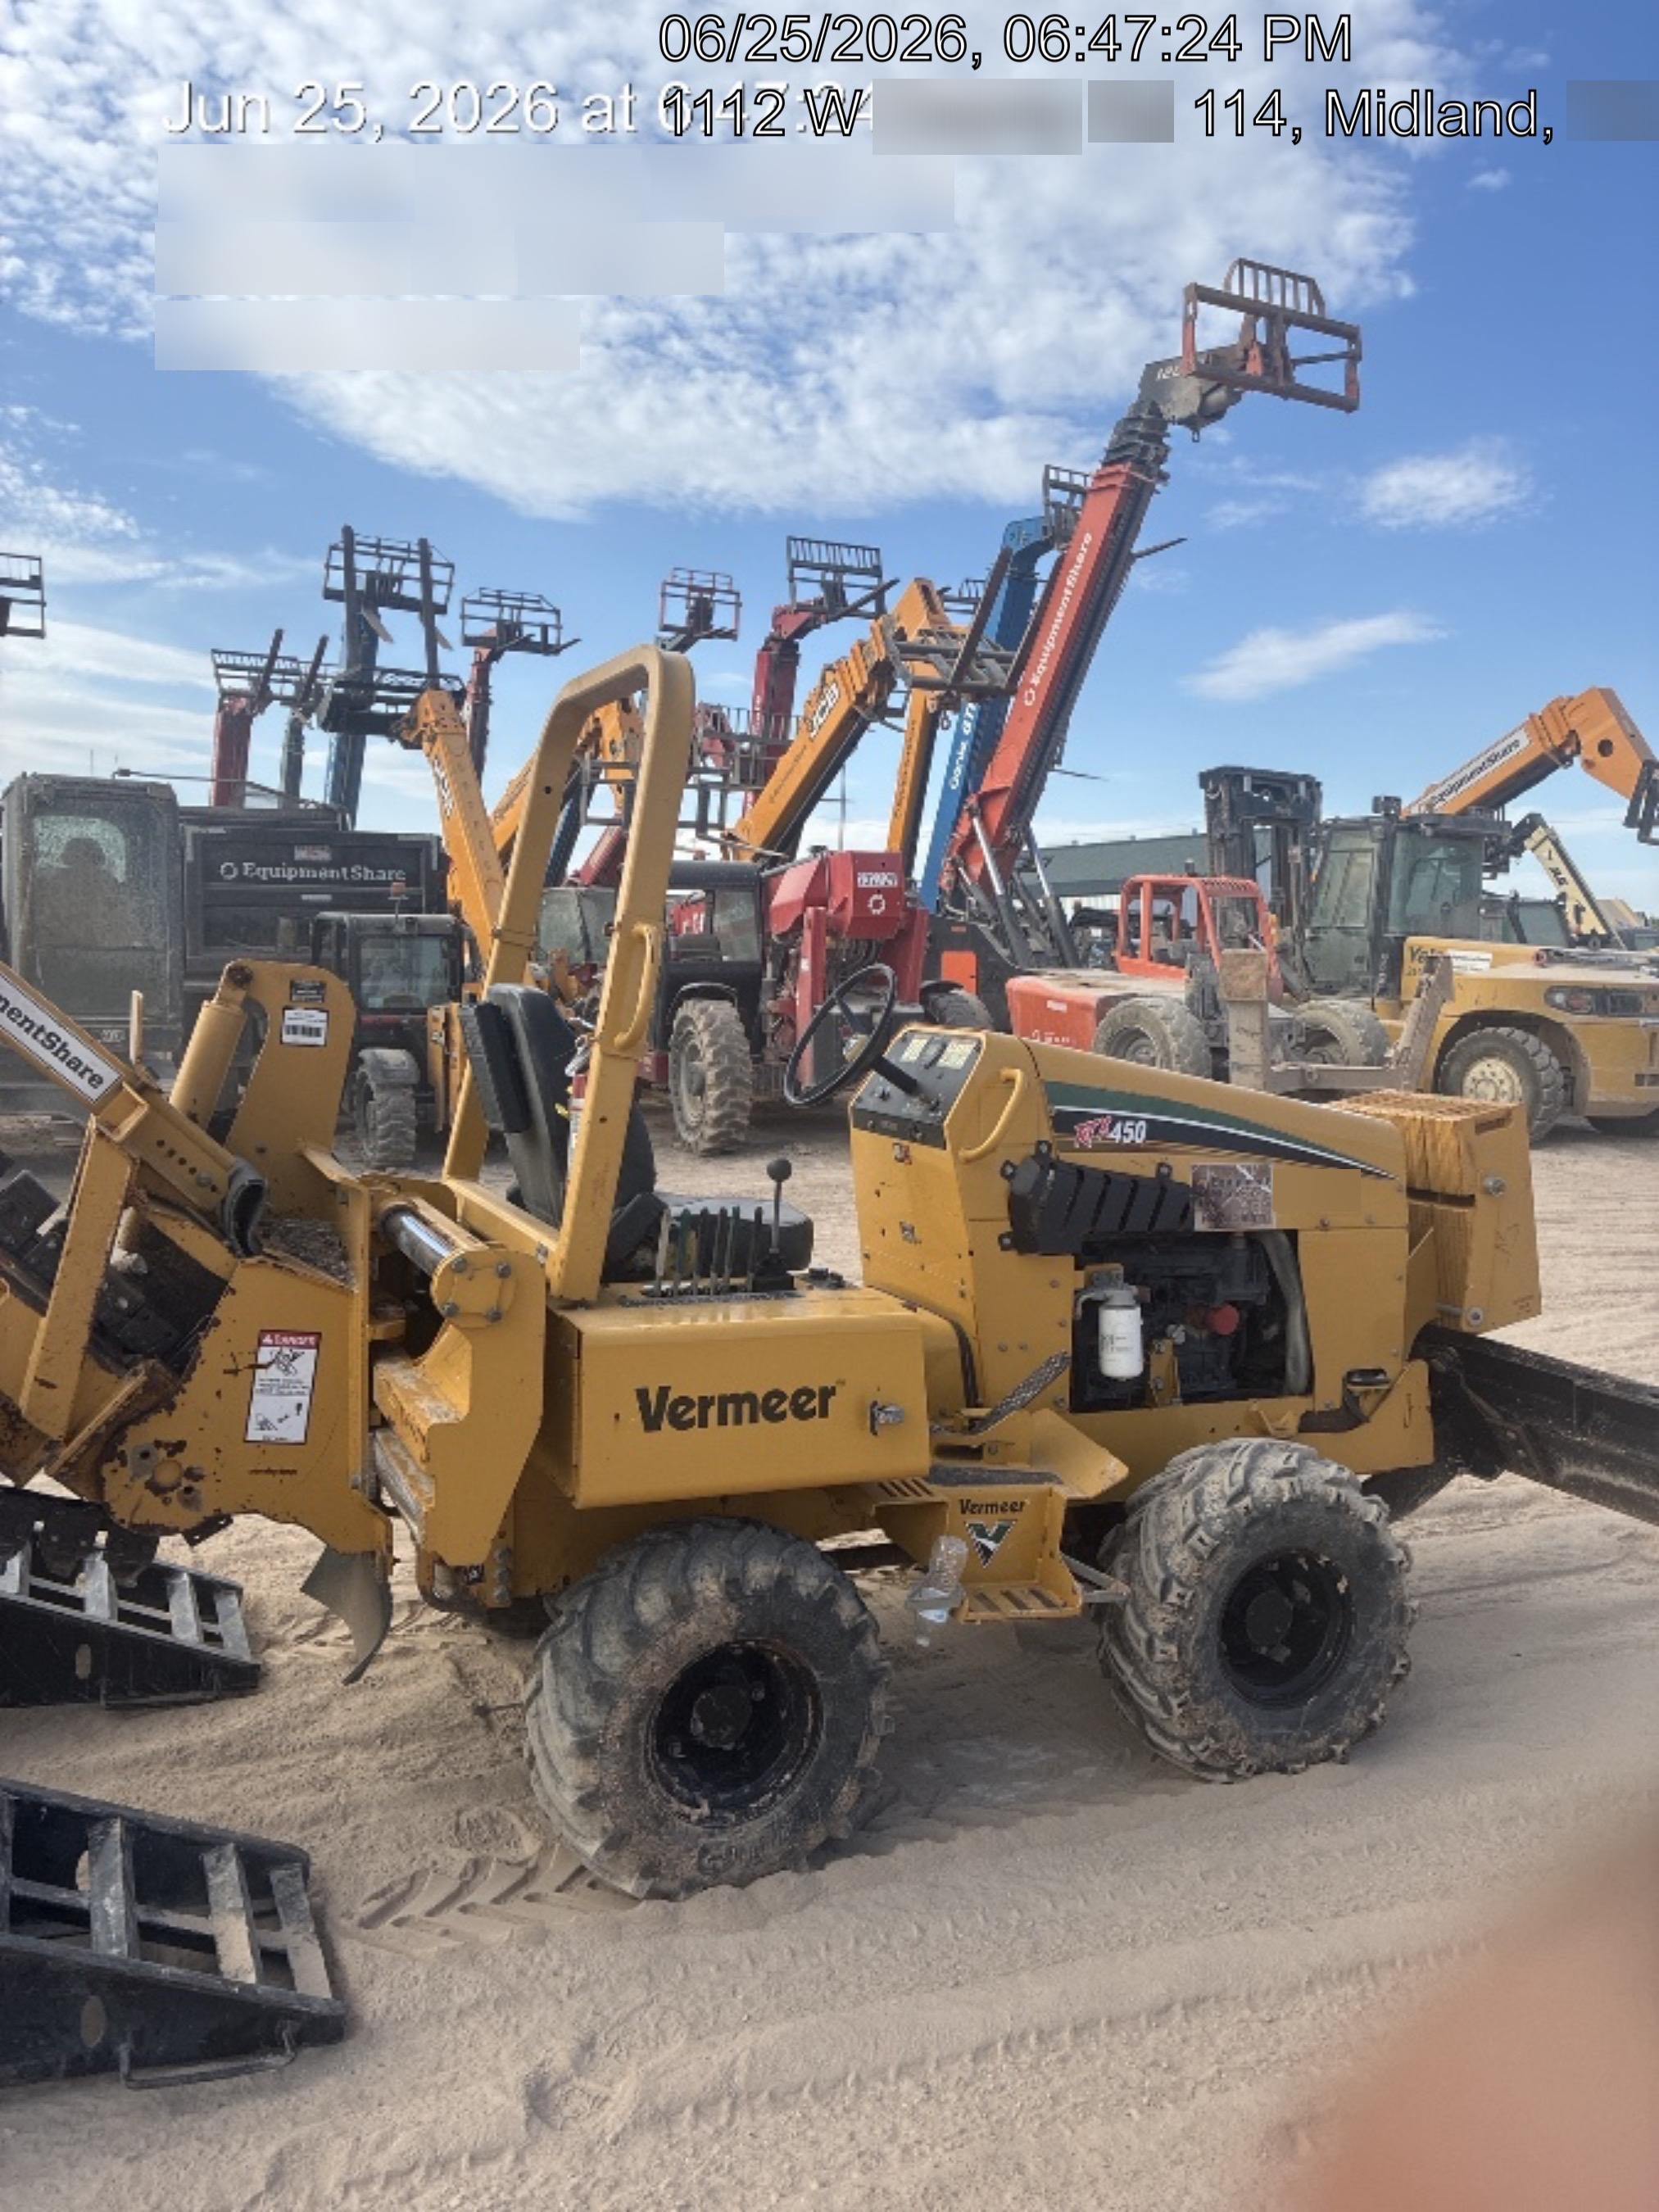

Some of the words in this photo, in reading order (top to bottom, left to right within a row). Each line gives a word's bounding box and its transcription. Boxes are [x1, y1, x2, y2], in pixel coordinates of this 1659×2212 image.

[1031, 533, 1092, 687] EquipmentShare
[242, 862, 406, 882] EquipmentShare
[635, 1385, 836, 1433] Vermeer
[959, 1498, 1025, 1515] Vermeer
